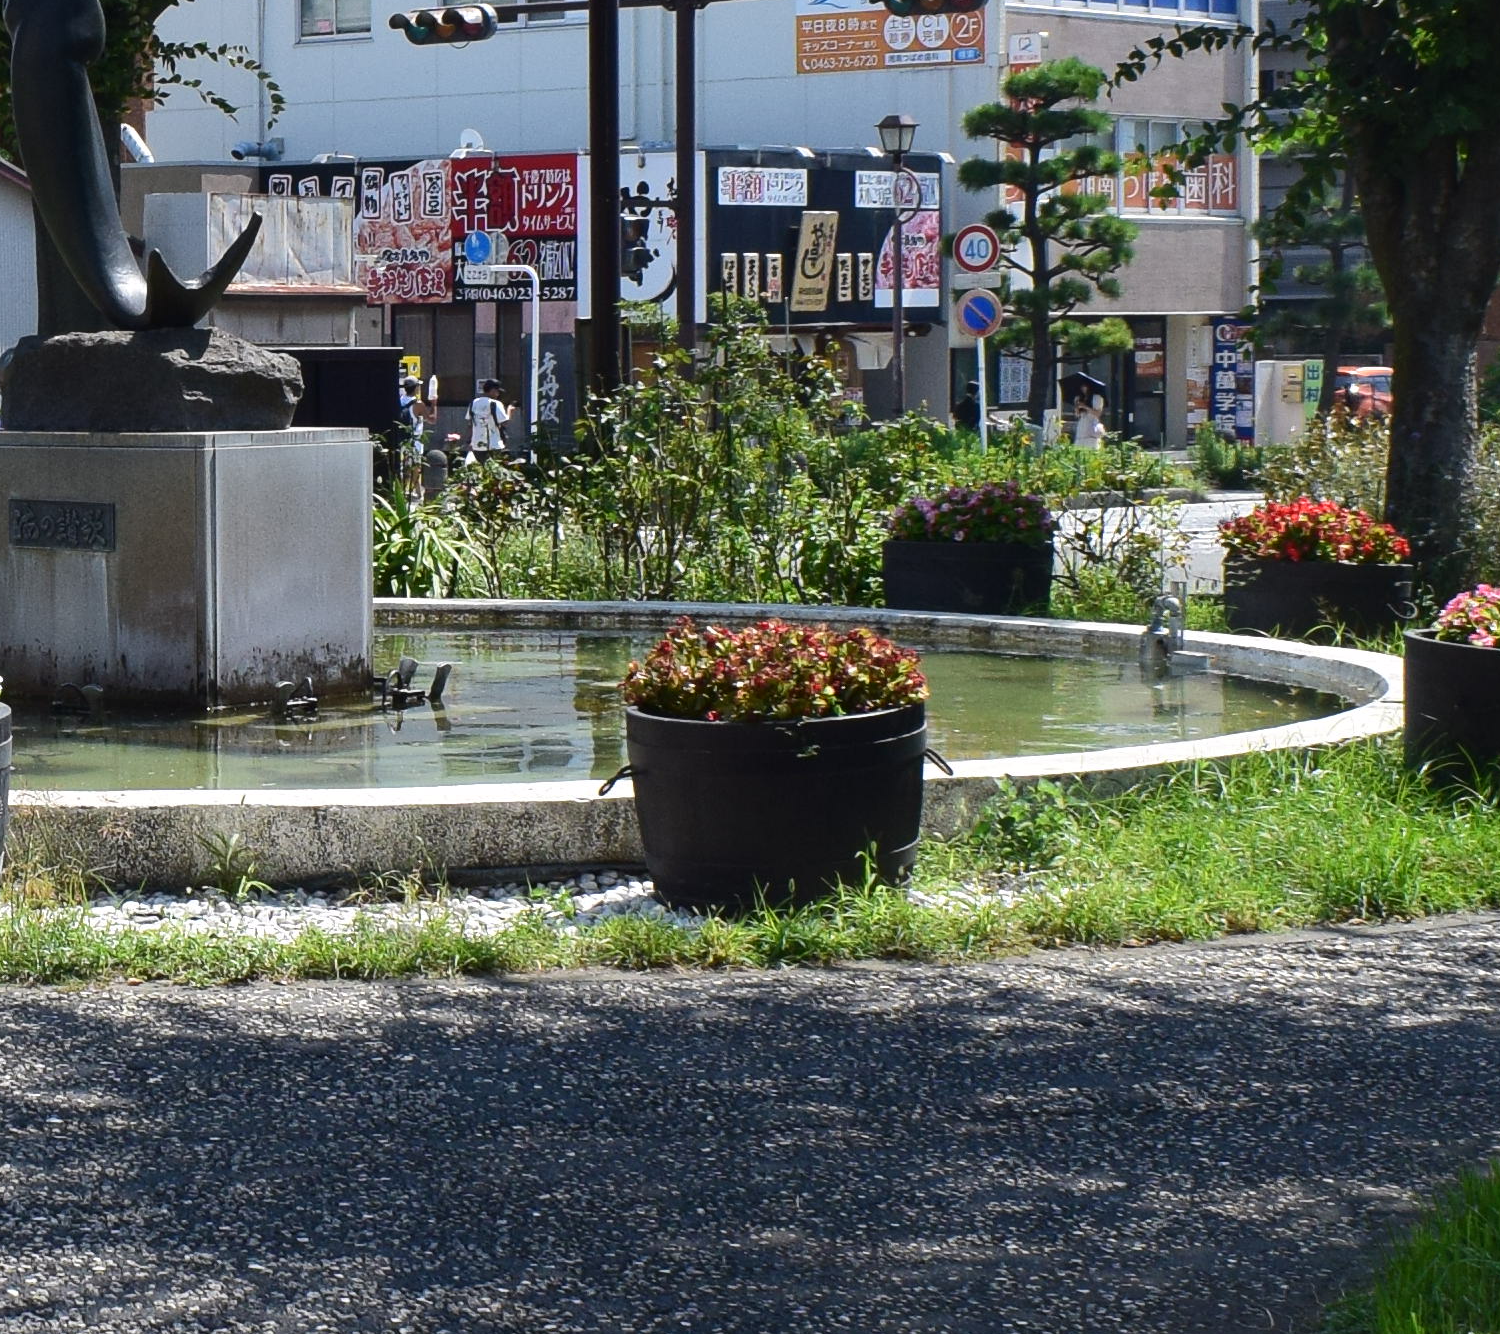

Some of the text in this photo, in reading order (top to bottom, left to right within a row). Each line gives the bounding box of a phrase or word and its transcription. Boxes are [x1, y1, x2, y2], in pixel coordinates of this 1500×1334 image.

[802, 18, 877, 34] 平日夜8時まで
[956, 16, 979, 38] 2F
[811, 54, 878, 69] 0463-73-6720
[522, 183, 573, 208] ドリンク
[766, 179, 803, 191] ドリンク
[452, 168, 520, 233] 半額
[965, 238, 990, 259] 40
